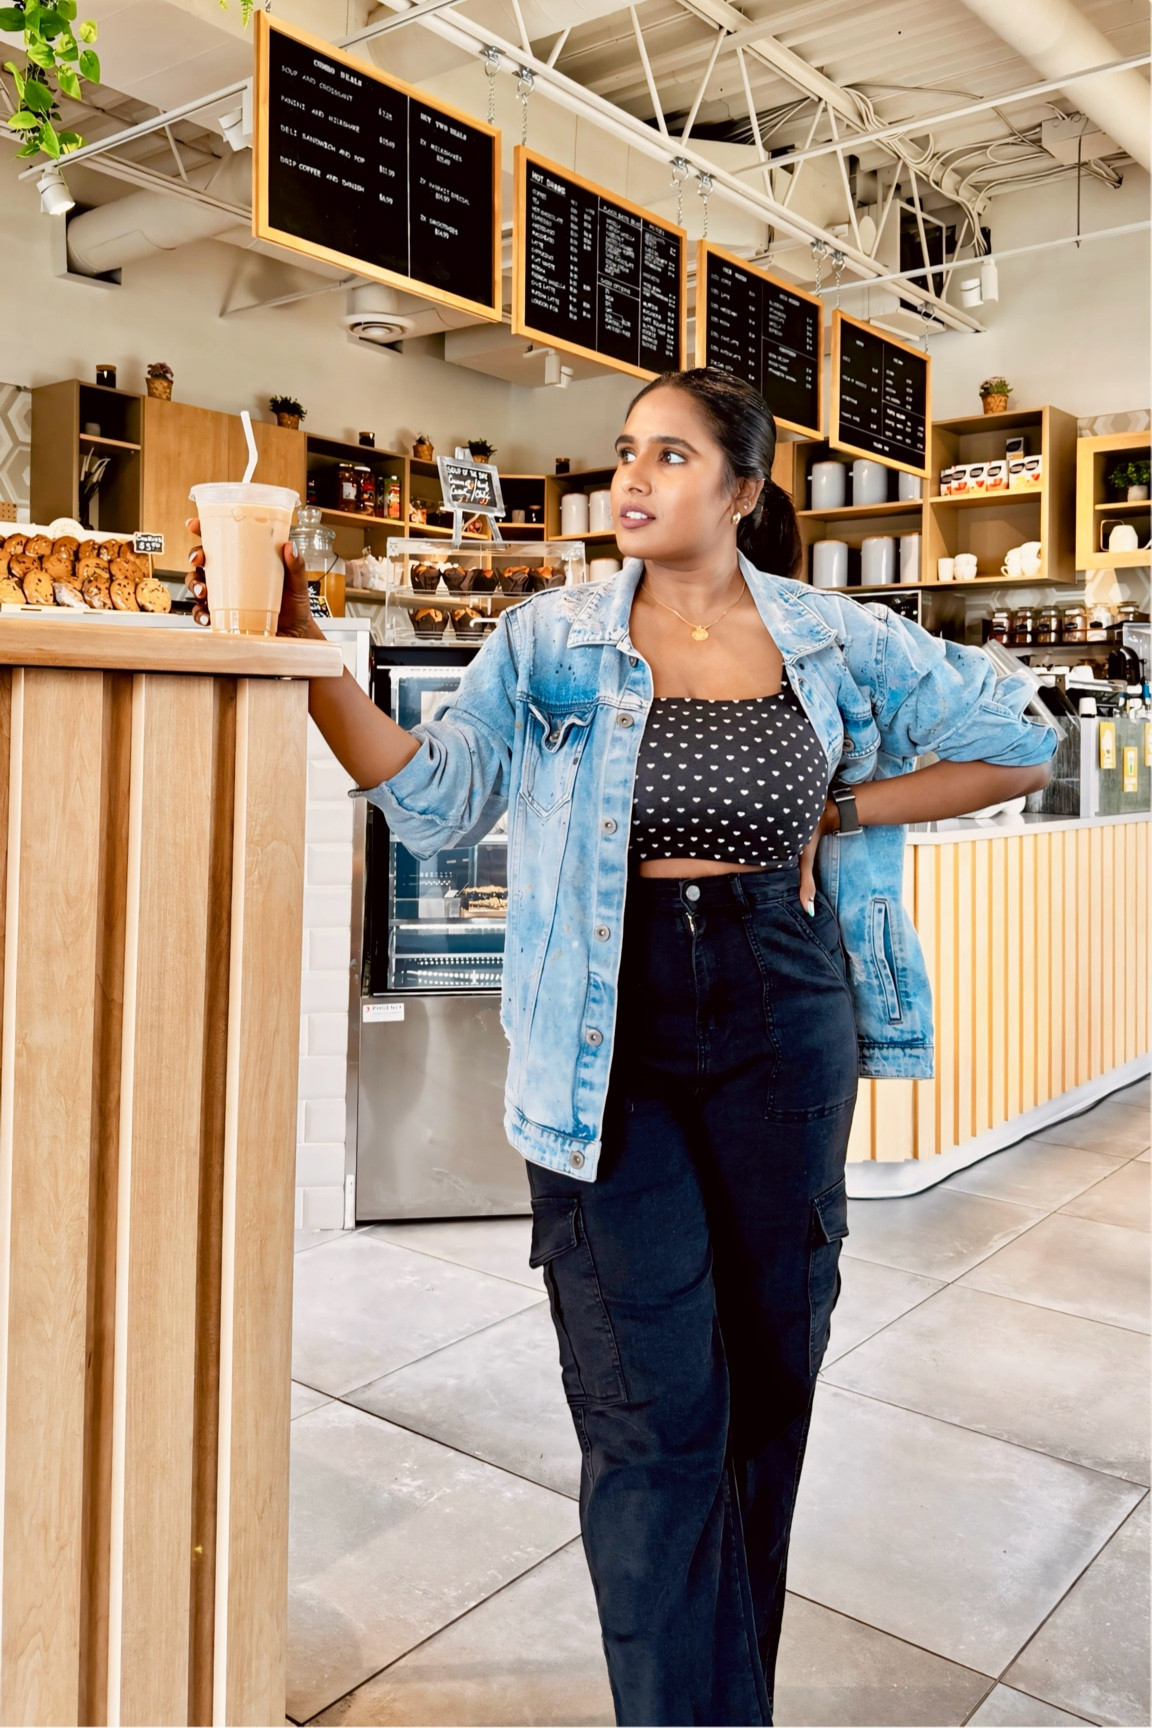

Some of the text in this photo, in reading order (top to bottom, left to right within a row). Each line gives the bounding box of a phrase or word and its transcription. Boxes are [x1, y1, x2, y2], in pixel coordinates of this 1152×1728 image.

[281, 65, 298, 76] SOUP
[302, 75, 316, 84] AND
[319, 82, 353, 101] CROISSANT
[313, 59, 362, 86] COMBO DEALS
[281, 95, 305, 110] PANINI
[311, 109, 324, 118] AND
[328, 116, 360, 133] MILKSHAKE
[435, 121, 448, 131] TWO
[280, 124, 297, 136] DELI
[302, 133, 336, 151] SANDWICH
[339, 149, 351, 158] AND
[354, 155, 365, 163] POP
[280, 155, 297, 166] DRIP
[298, 163, 321, 177] COFFEE
[326, 174, 338, 183] AND
[341, 179, 364, 192] DANISH
[532, 171, 565, 195] HOT DRINKS
